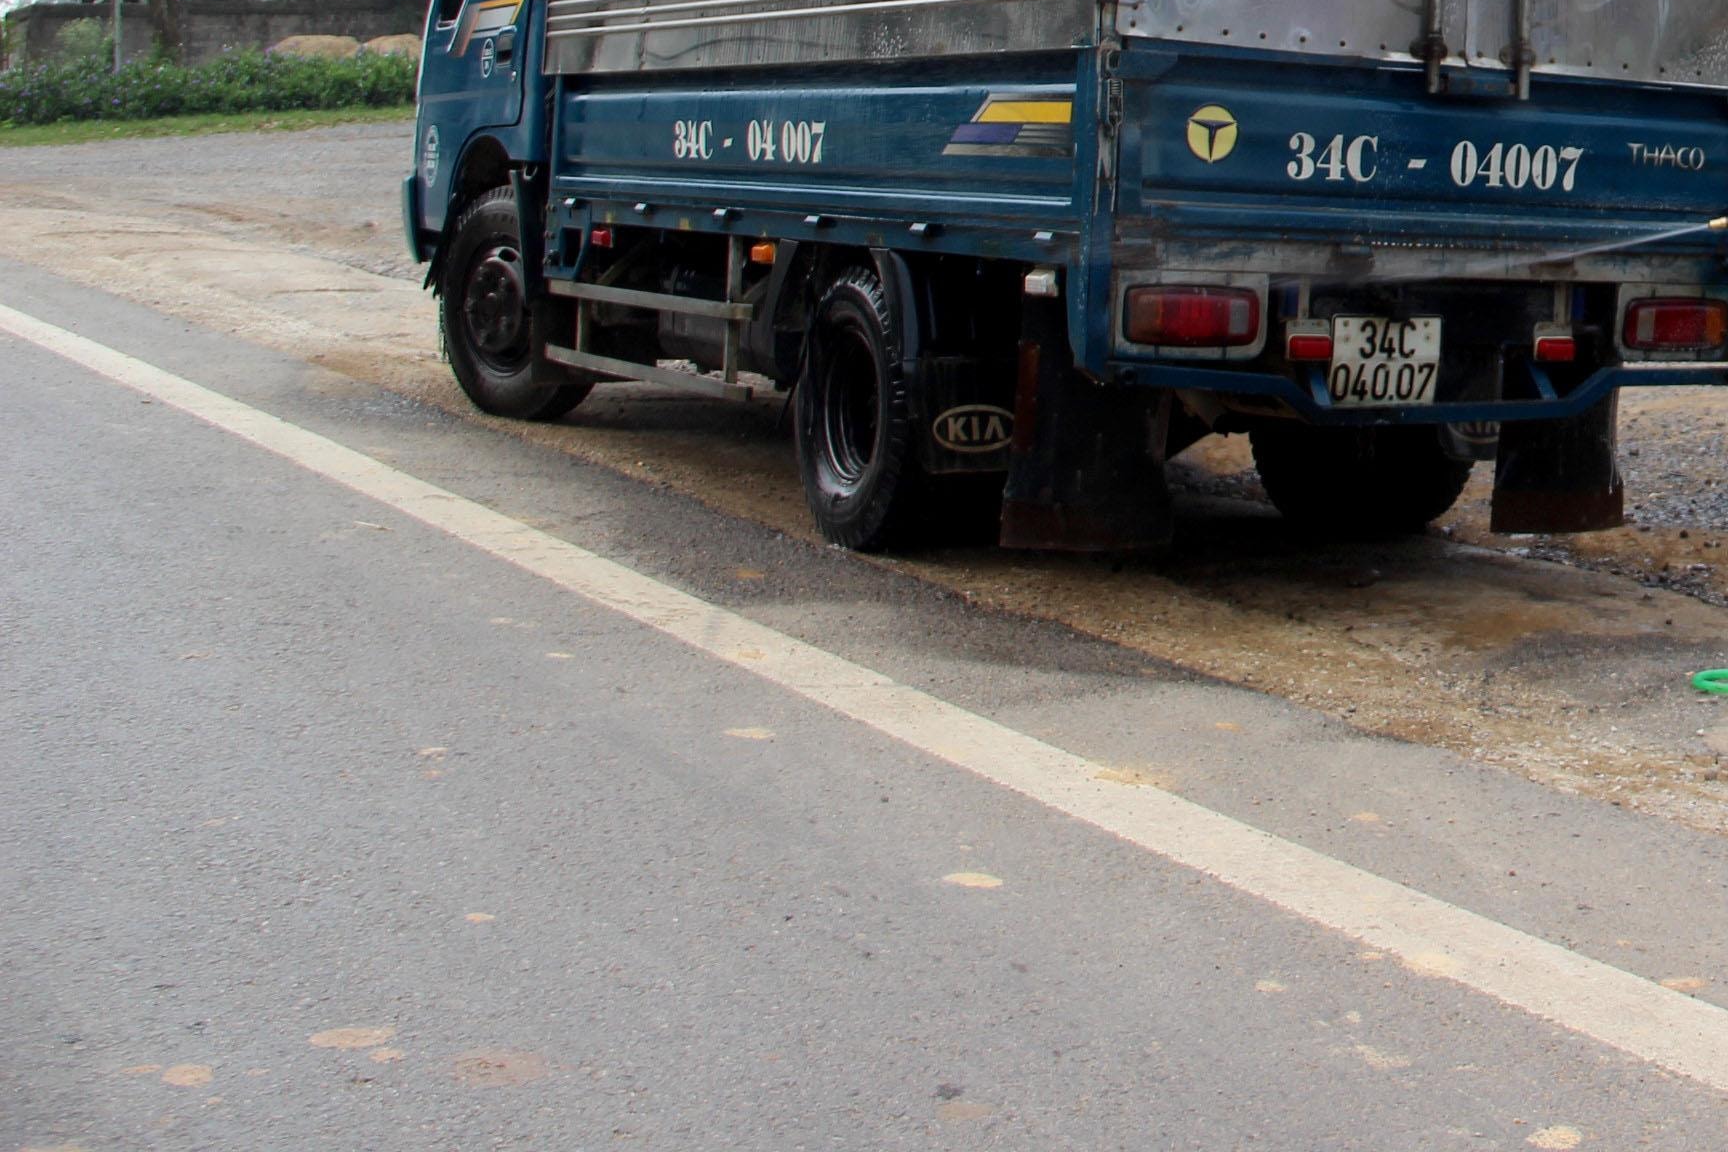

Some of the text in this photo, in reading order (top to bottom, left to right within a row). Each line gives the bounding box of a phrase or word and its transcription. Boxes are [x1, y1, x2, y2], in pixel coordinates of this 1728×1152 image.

[674, 119, 713, 159] 34C
[1627, 142, 1705, 170] THACO
[1287, 132, 1378, 182] 34C
[1450, 140, 1584, 191] 04007
[1359, 320, 1416, 359] 34C
[1332, 362, 1436, 401] 040.07
[947, 416, 1006, 440] KIA
